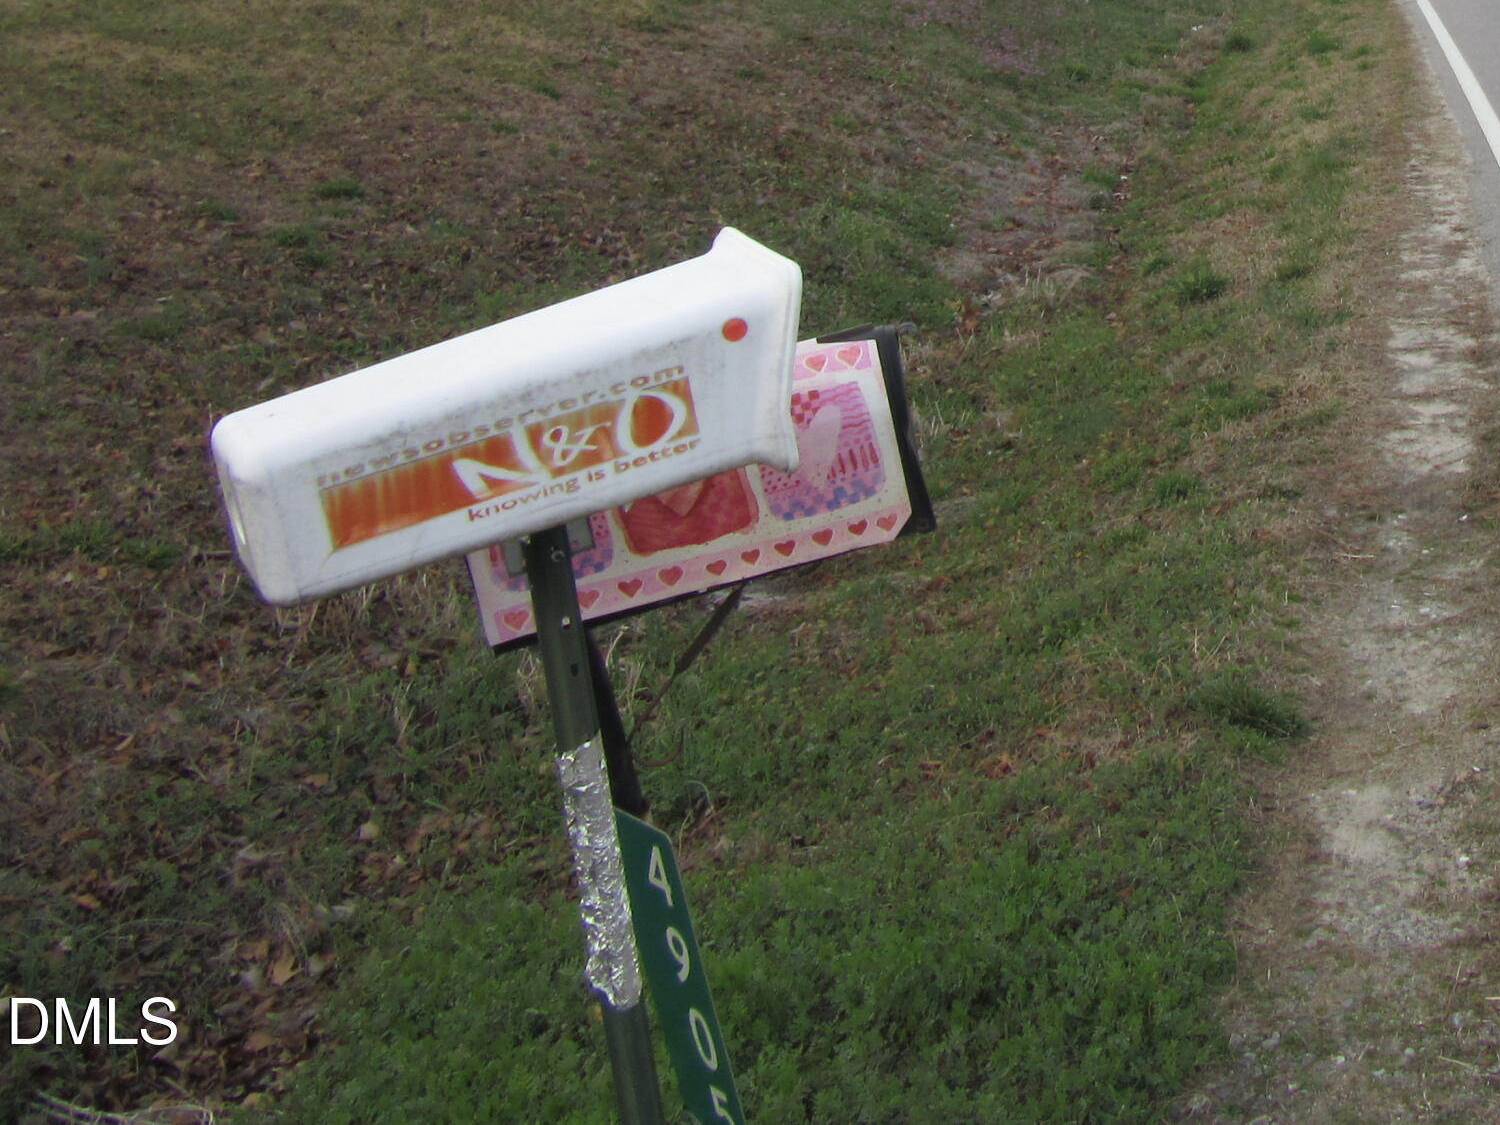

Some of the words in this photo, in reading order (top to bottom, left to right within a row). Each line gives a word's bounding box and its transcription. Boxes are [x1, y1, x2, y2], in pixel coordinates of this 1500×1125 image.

[316, 364, 685, 487] newsobserver.com
[451, 387, 688, 501] N&O
[467, 476, 581, 523] knowing
[586, 468, 606, 483] is
[613, 437, 702, 474] better
